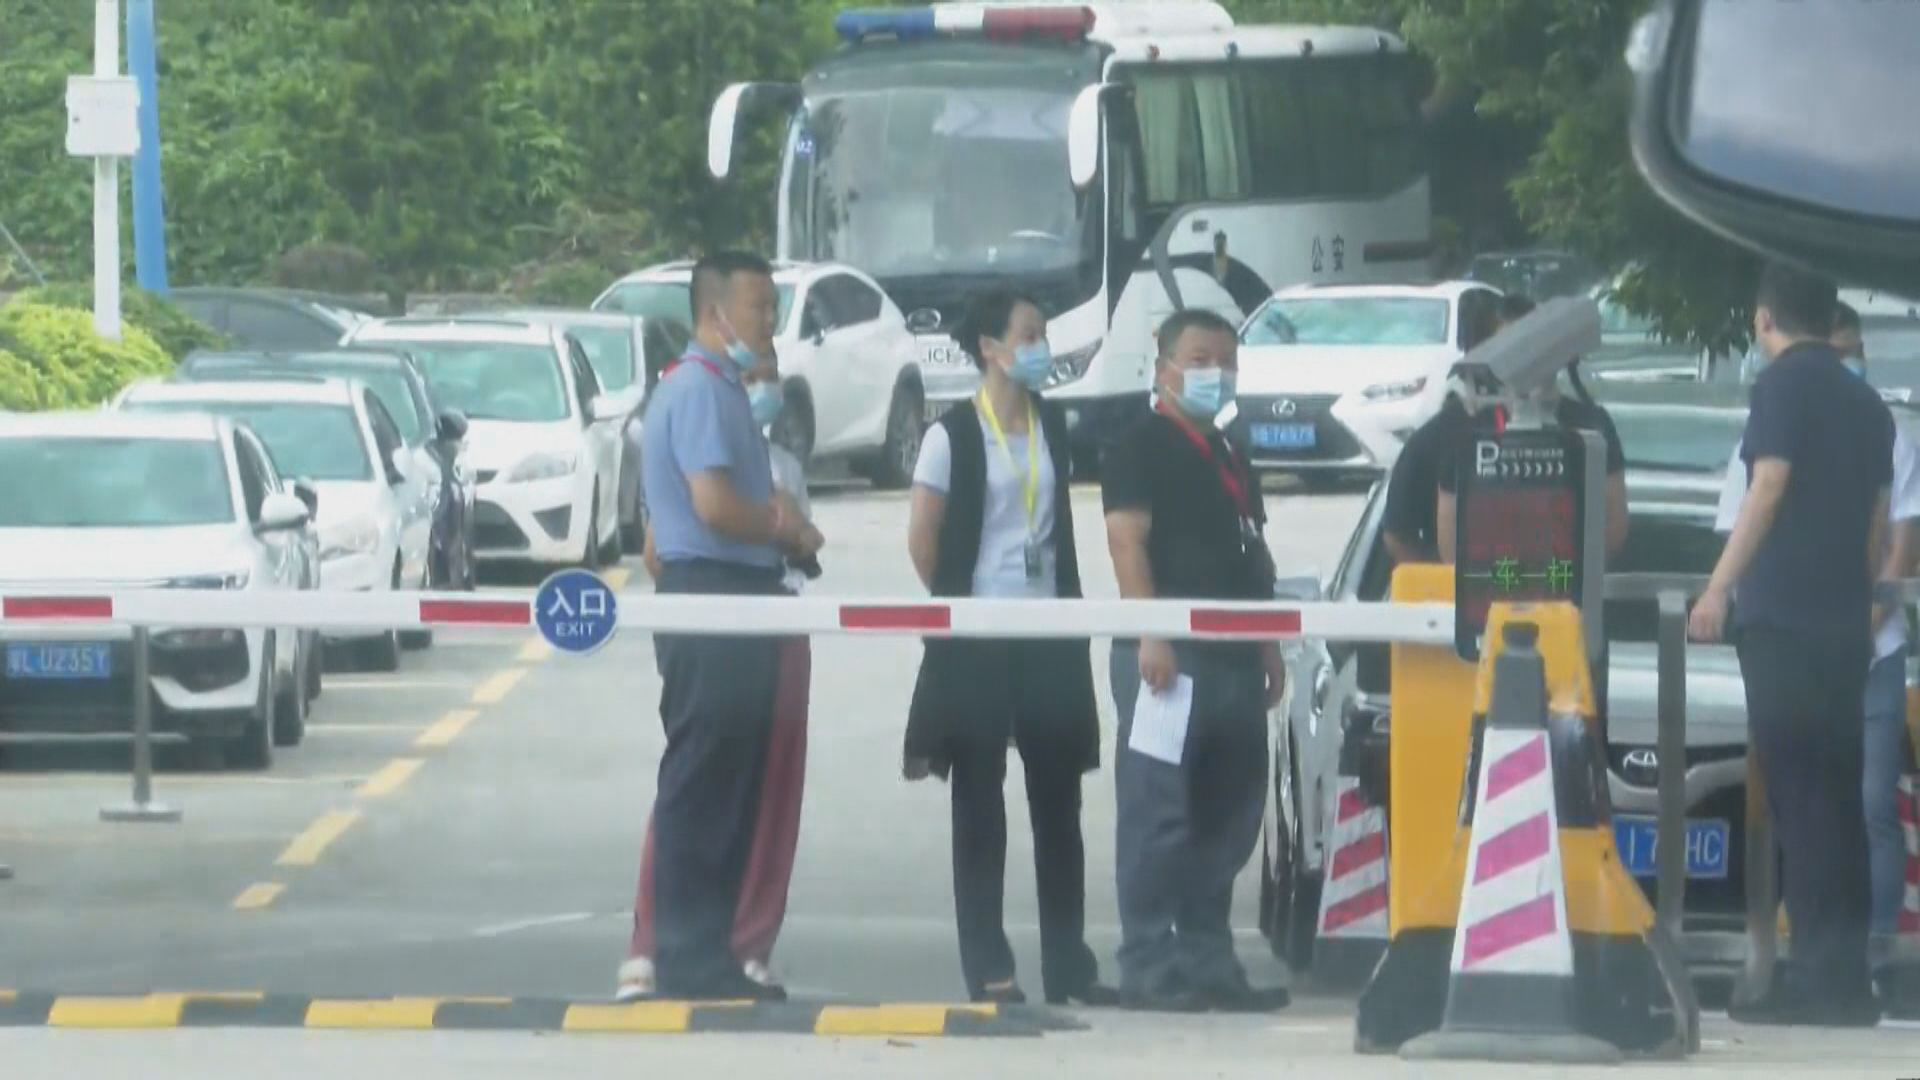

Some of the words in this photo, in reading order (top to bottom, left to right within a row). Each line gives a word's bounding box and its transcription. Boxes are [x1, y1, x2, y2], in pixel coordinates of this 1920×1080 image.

[1311, 234, 1345, 272] 公安
[1464, 556, 1574, 593] 一车一杆
[547, 586, 605, 617] 入口
[556, 621, 594, 636] EXIT
